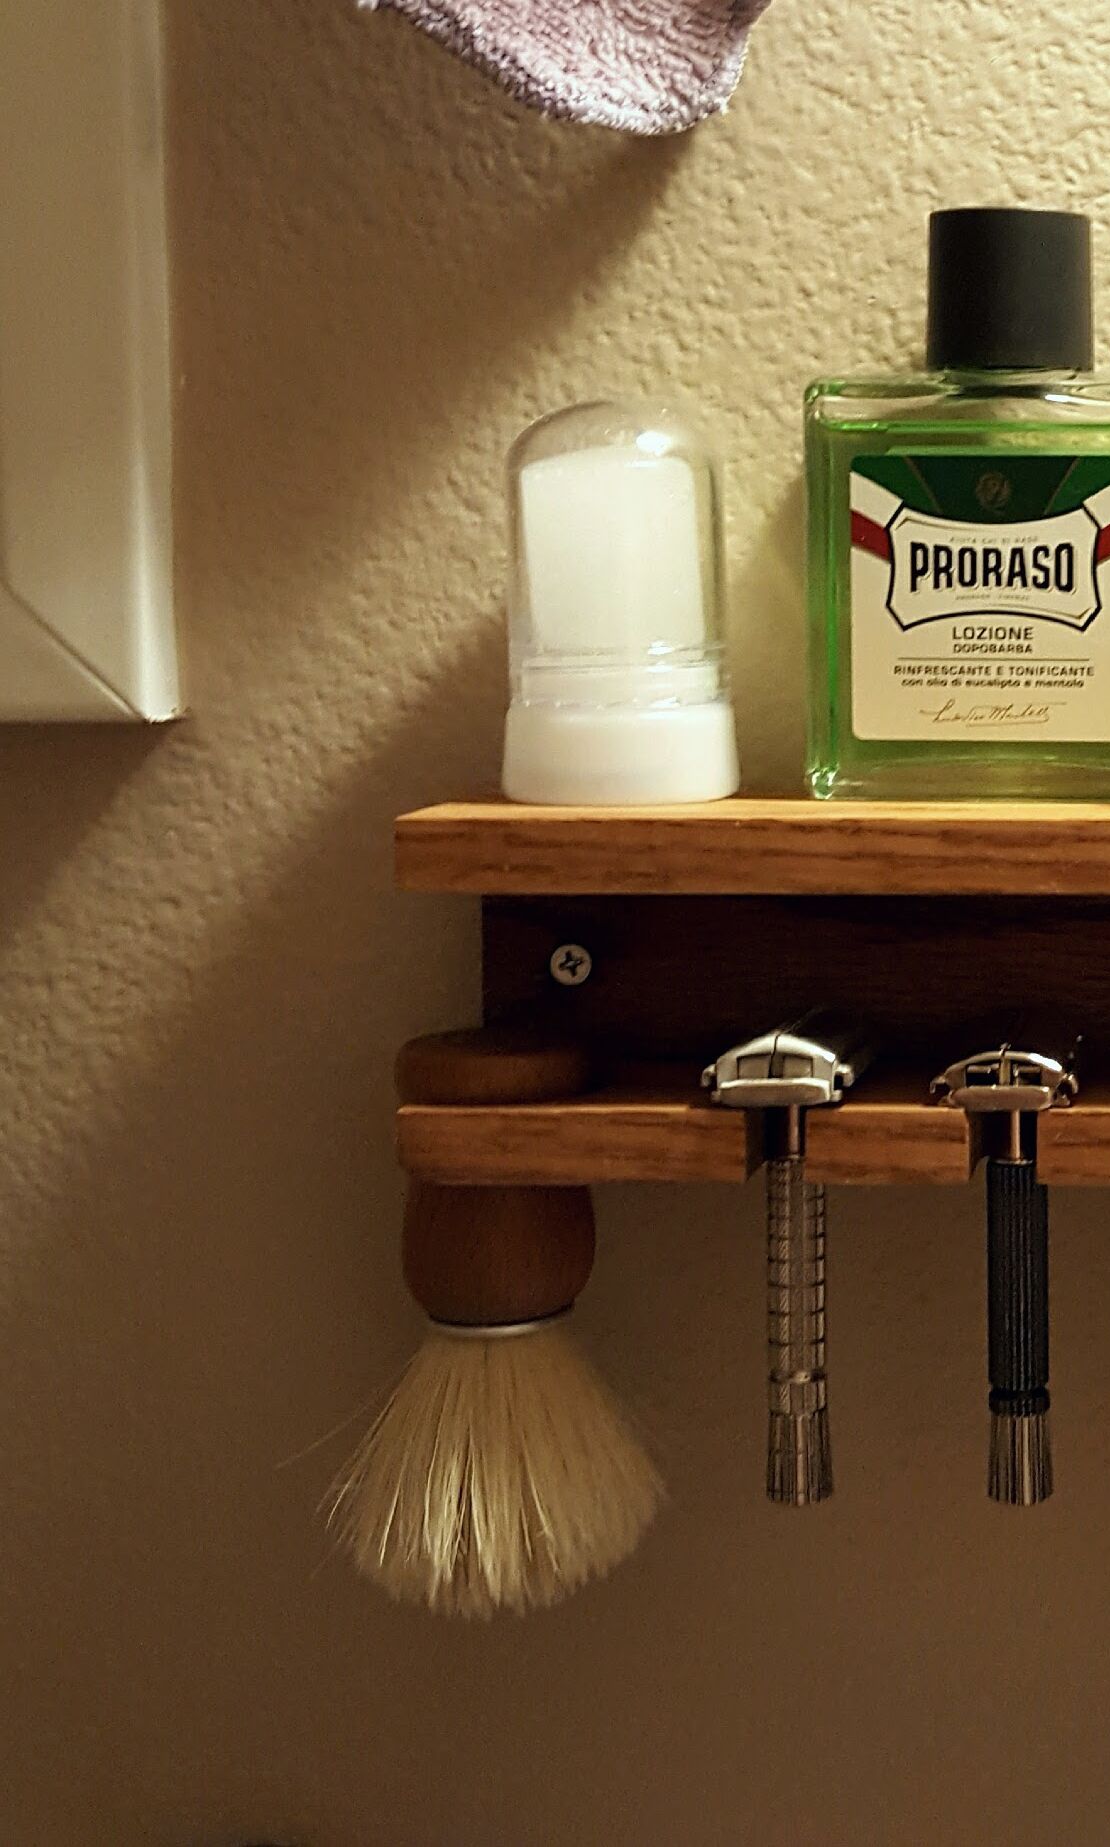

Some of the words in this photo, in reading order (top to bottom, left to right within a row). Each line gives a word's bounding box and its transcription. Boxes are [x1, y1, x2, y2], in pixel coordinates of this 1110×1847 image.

[910, 541, 1075, 592] PRORASO
[952, 627, 1034, 640] LOZIONE
[953, 643, 1033, 654] DOPOBARBA
[893, 665, 991, 676] RINFRESCANTE
[997, 666, 1004, 676] E
[1009, 666, 1095, 677] TONIFICANTE
